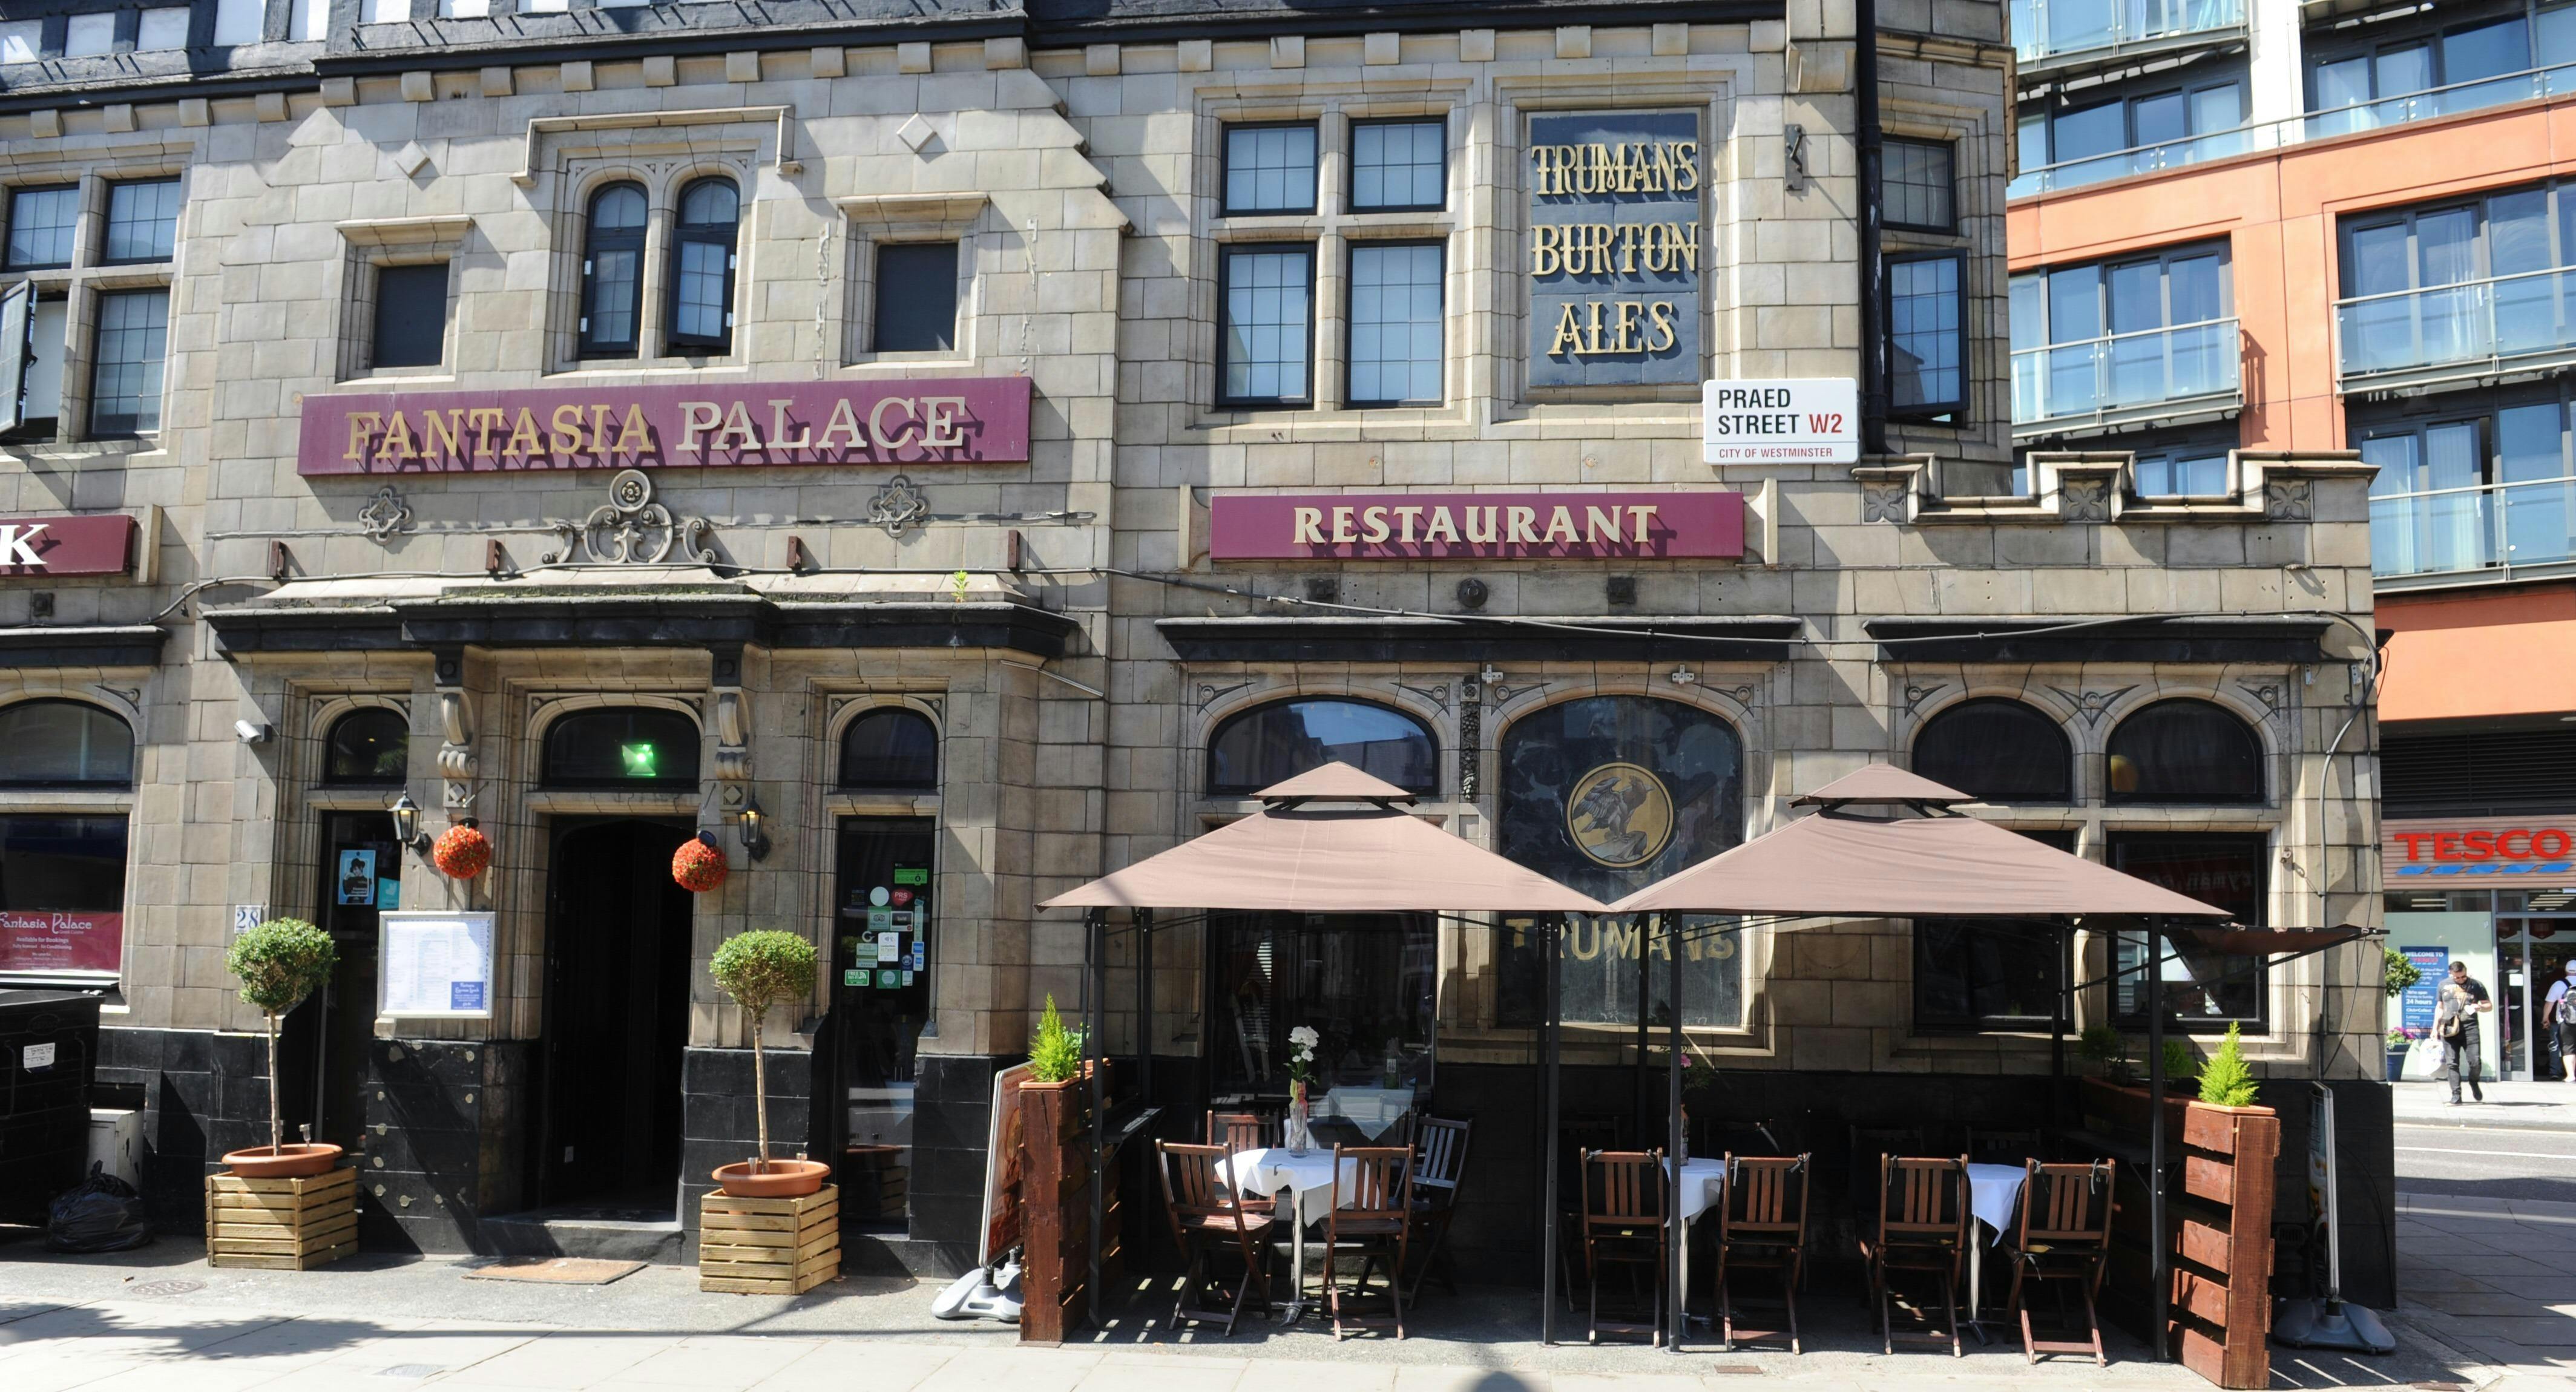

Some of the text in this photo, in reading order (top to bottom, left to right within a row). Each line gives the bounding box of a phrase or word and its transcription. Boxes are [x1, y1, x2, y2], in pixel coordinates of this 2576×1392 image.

[1531, 142, 1698, 195] TRUMANS
[1531, 222, 1698, 275] BURTON
[1547, 301, 1674, 355] ALES
[1719, 389, 1791, 409] PRAED
[343, 396, 966, 460] FANTASIA PALACE
[1718, 413, 1843, 435] STREET W2
[1719, 448, 1833, 458] CITY OF WESTMINSTER
[1293, 505, 1658, 544] RESTAURANT
[2394, 829, 2572, 861] TESCO
[51, 913, 92, 934] Palace
[236, 908, 258, 930] 28
[1505, 917, 1735, 961] TUMANS
